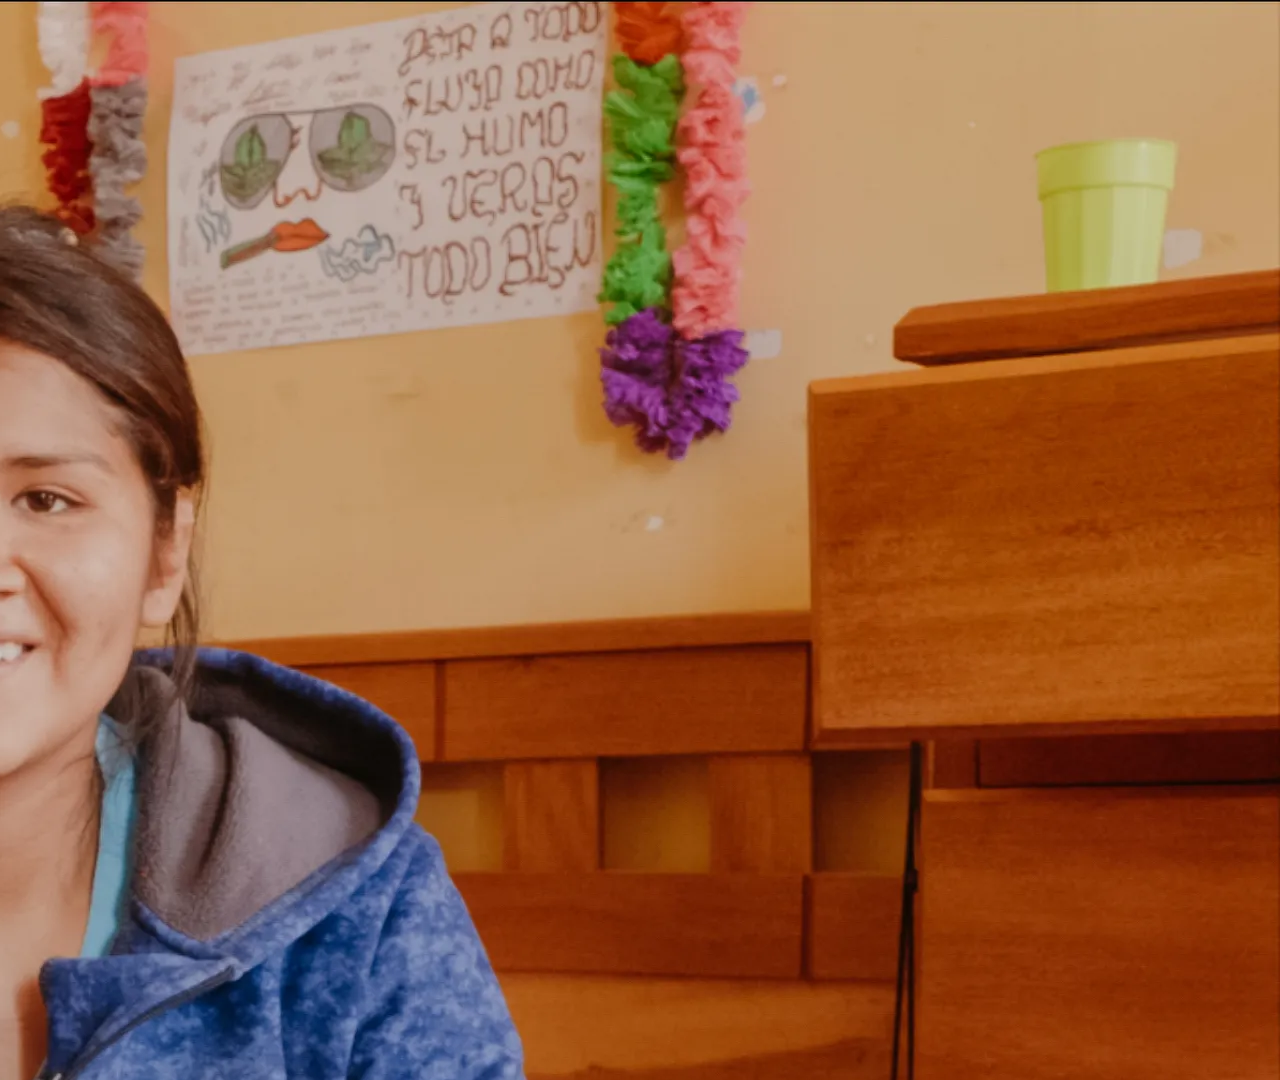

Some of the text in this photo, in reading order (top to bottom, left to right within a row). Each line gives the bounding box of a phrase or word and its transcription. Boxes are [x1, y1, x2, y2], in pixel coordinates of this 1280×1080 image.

[460, 102, 568, 157] HUMO
[397, 211, 596, 306] TODO BIEN
